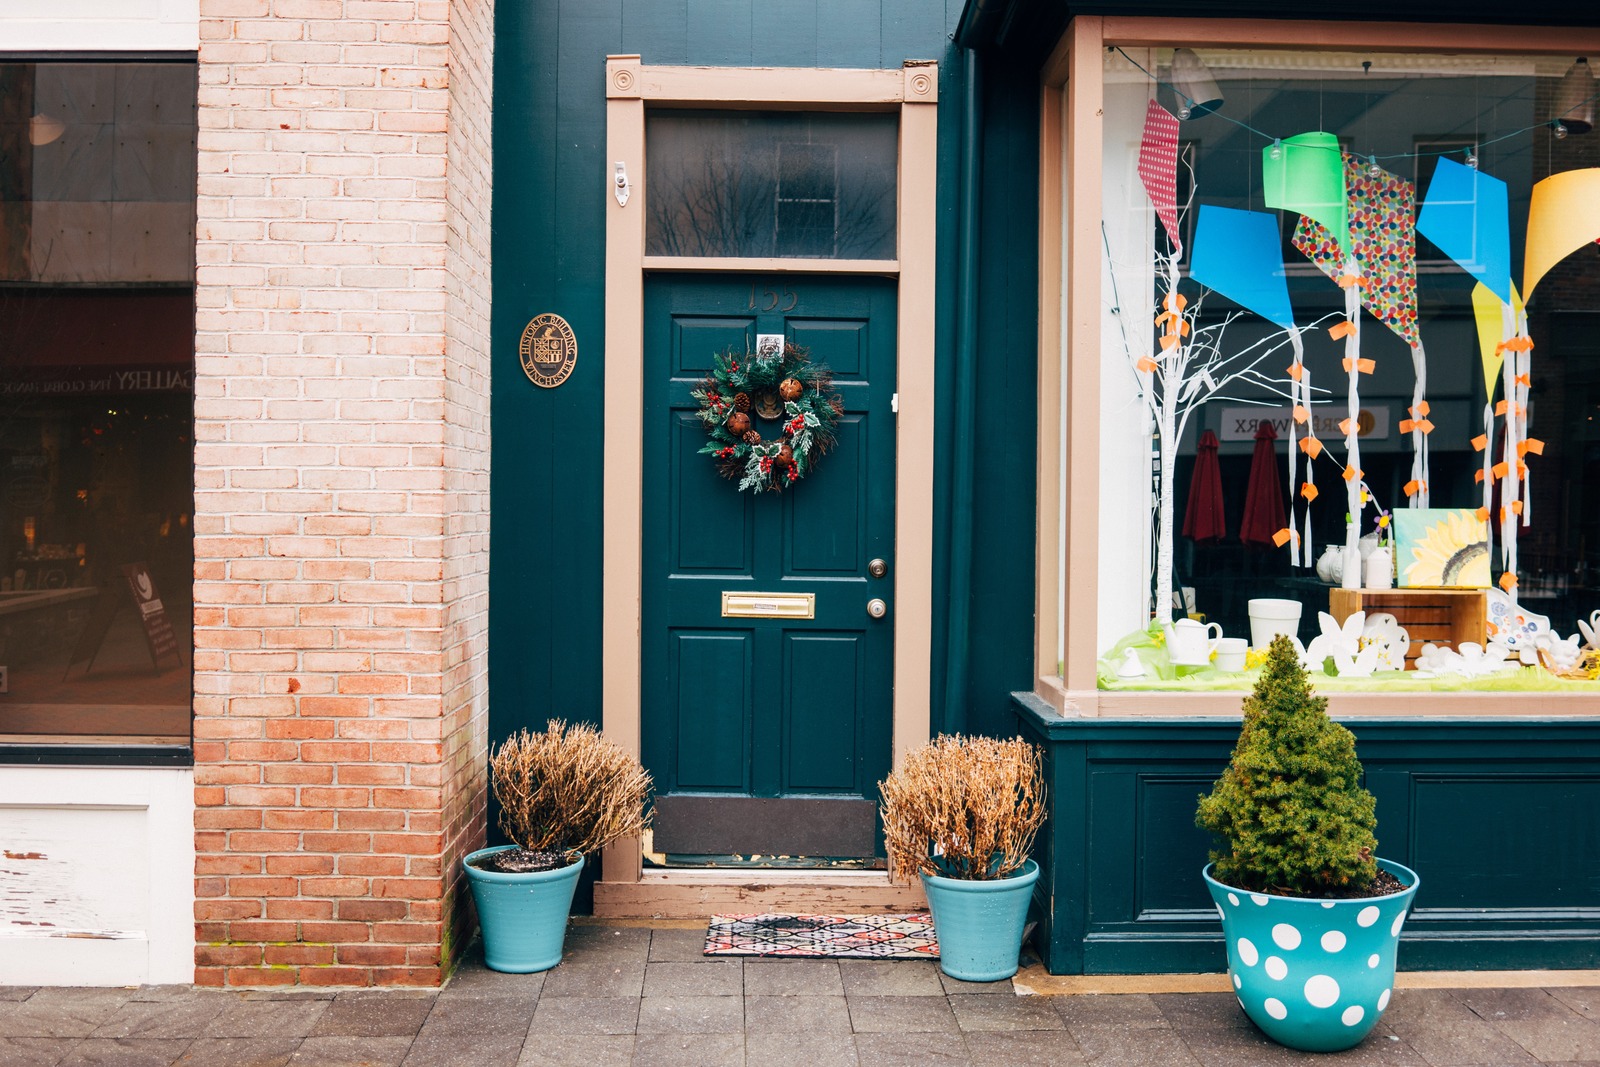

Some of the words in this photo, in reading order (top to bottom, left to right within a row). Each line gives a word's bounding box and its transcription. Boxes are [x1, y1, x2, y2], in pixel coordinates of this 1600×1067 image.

[749, 280, 798, 312] 155
[522, 316, 547, 354] HISTORIC
[550, 316, 576, 355] BUILDING
[525, 360, 574, 386] WINCHESTER
